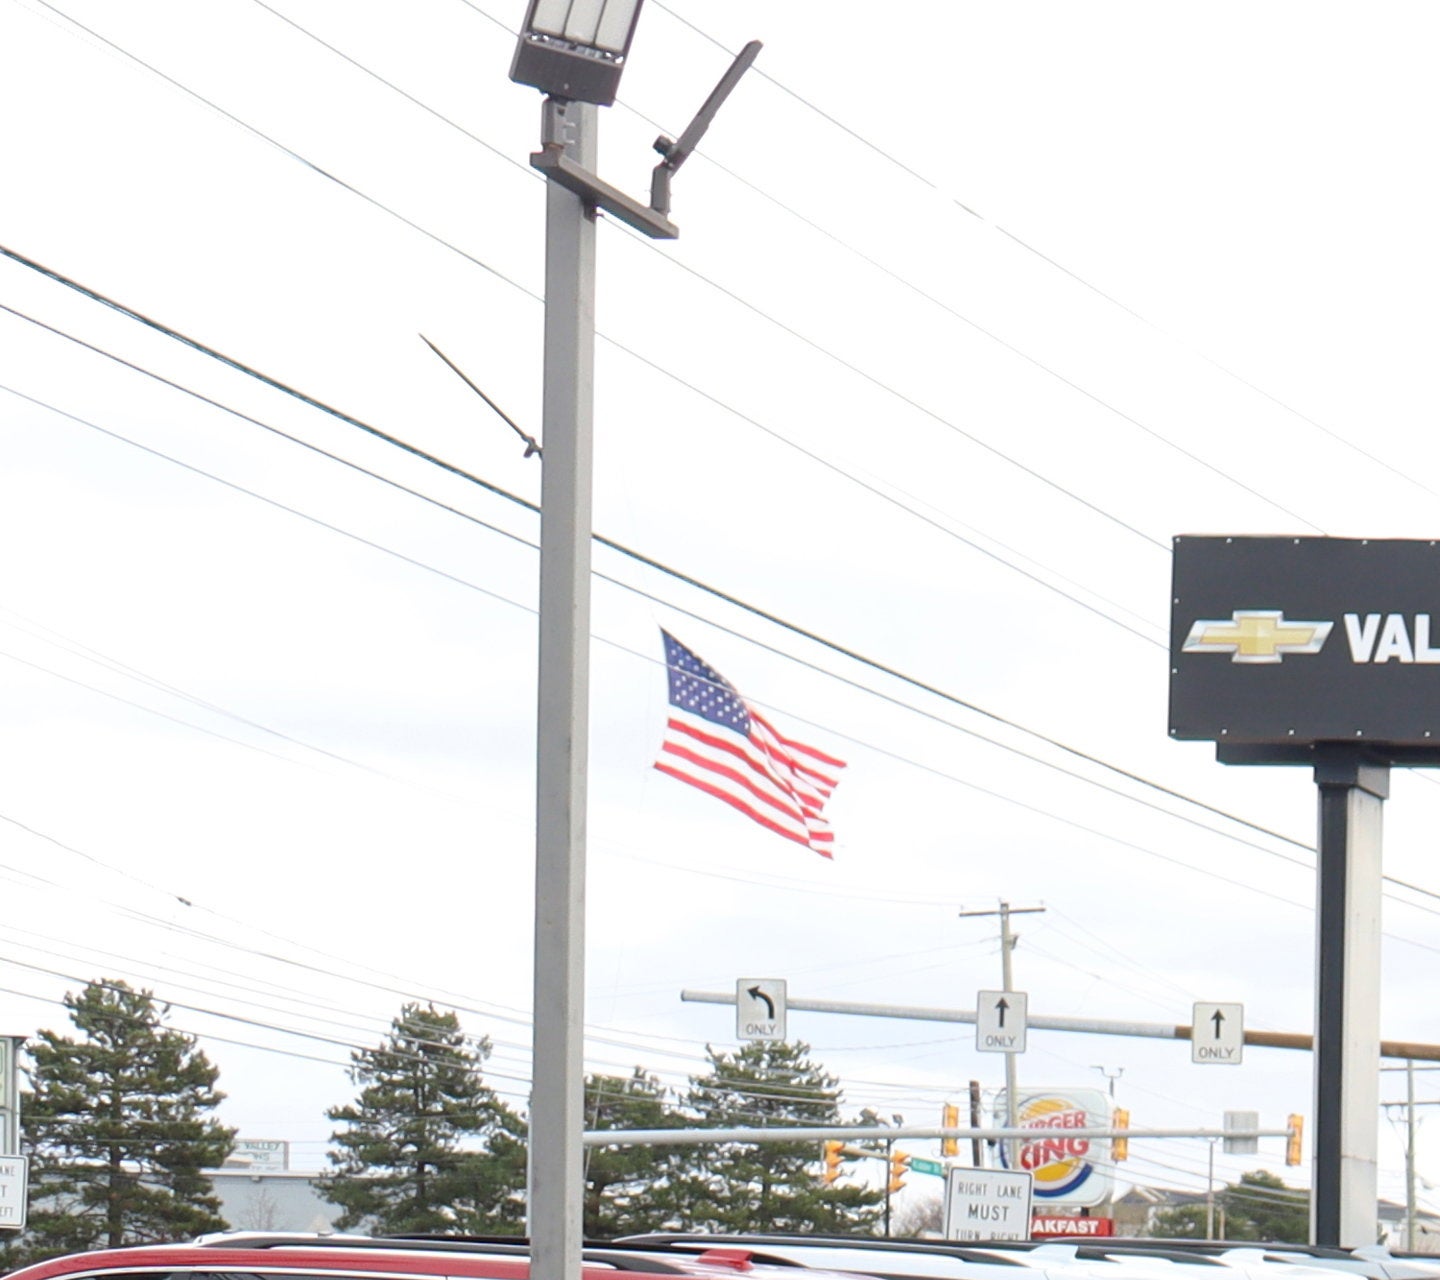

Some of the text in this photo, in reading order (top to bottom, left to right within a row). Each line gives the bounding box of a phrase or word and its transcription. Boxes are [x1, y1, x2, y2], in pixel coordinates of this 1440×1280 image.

[745, 1023, 777, 1036] ONLY
[985, 1035, 1017, 1048] ONLY
[1198, 1046, 1235, 1060] ONLY
[957, 1181, 1023, 1200] RIGHT LANE
[967, 1202, 1010, 1222] MUST
[1031, 1218, 1099, 1234] AKFAST
